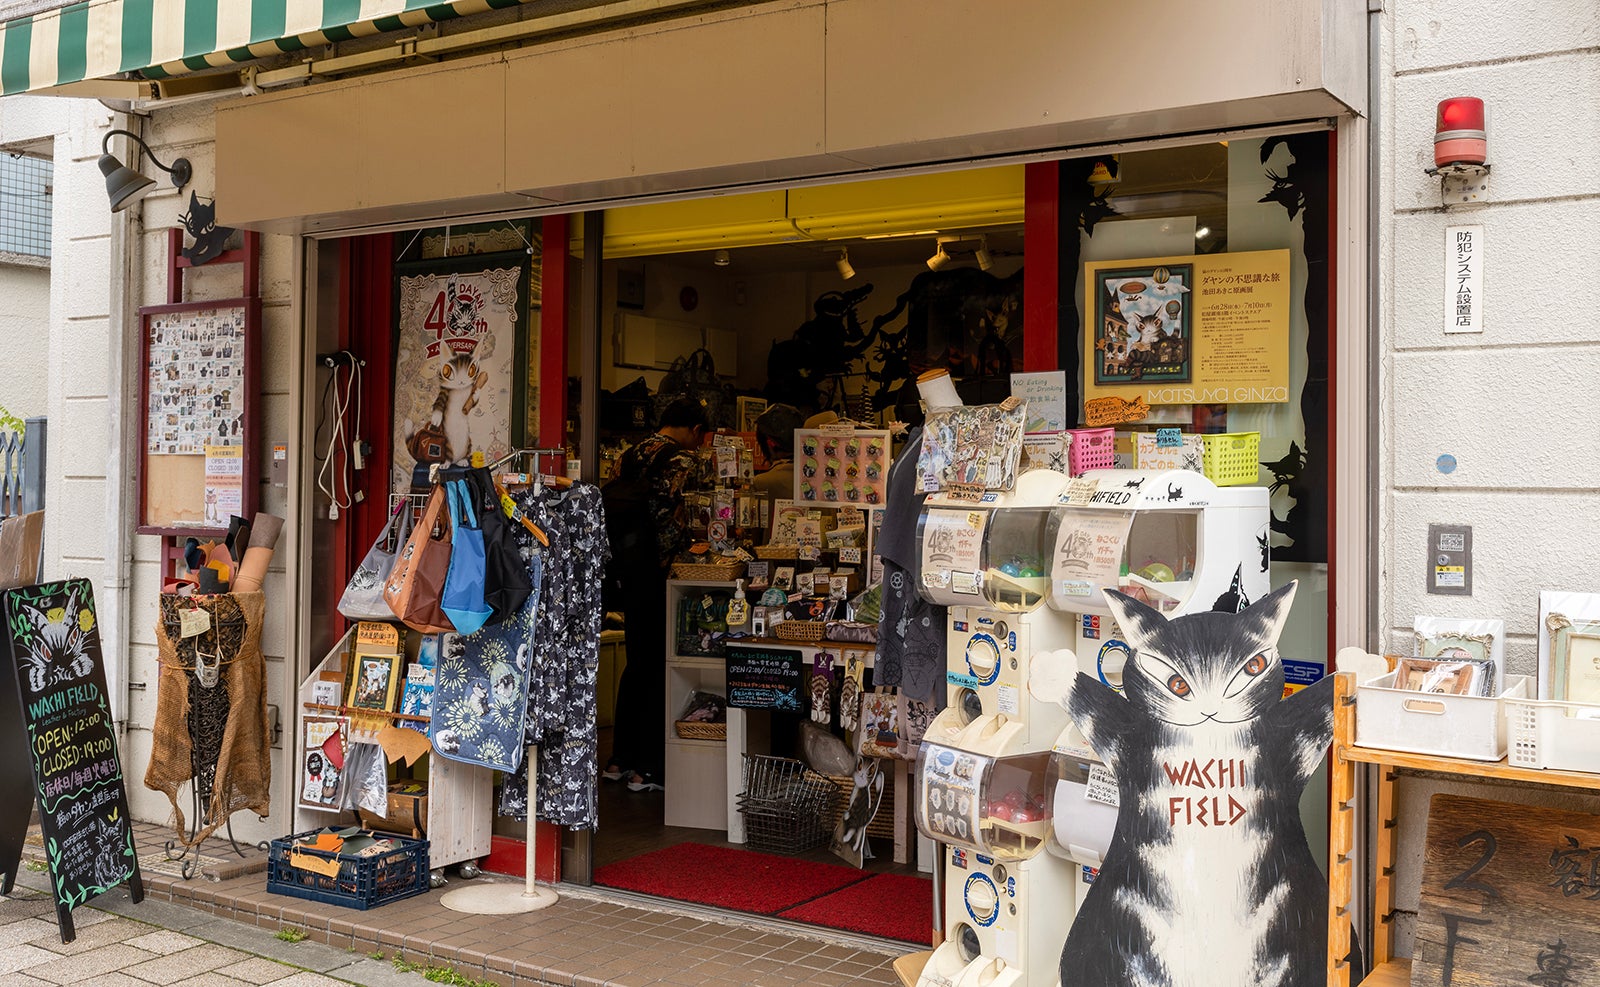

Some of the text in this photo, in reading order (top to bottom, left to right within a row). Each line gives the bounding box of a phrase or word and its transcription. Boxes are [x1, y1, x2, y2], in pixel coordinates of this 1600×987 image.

[1202, 273, 1280, 285] ダヤンの不思議な旅
[1202, 286, 1254, 296] 池田あきこ原画展
[1456, 231, 1472, 326] 防犯システム設置店
[459, 283, 485, 309] DAYAN
[435, 341, 475, 352] AVERSARY
[29, 682, 98, 720] WACHI FIELD
[1163, 757, 1244, 789] WACHI
[1168, 793, 1247, 828] FIELD
